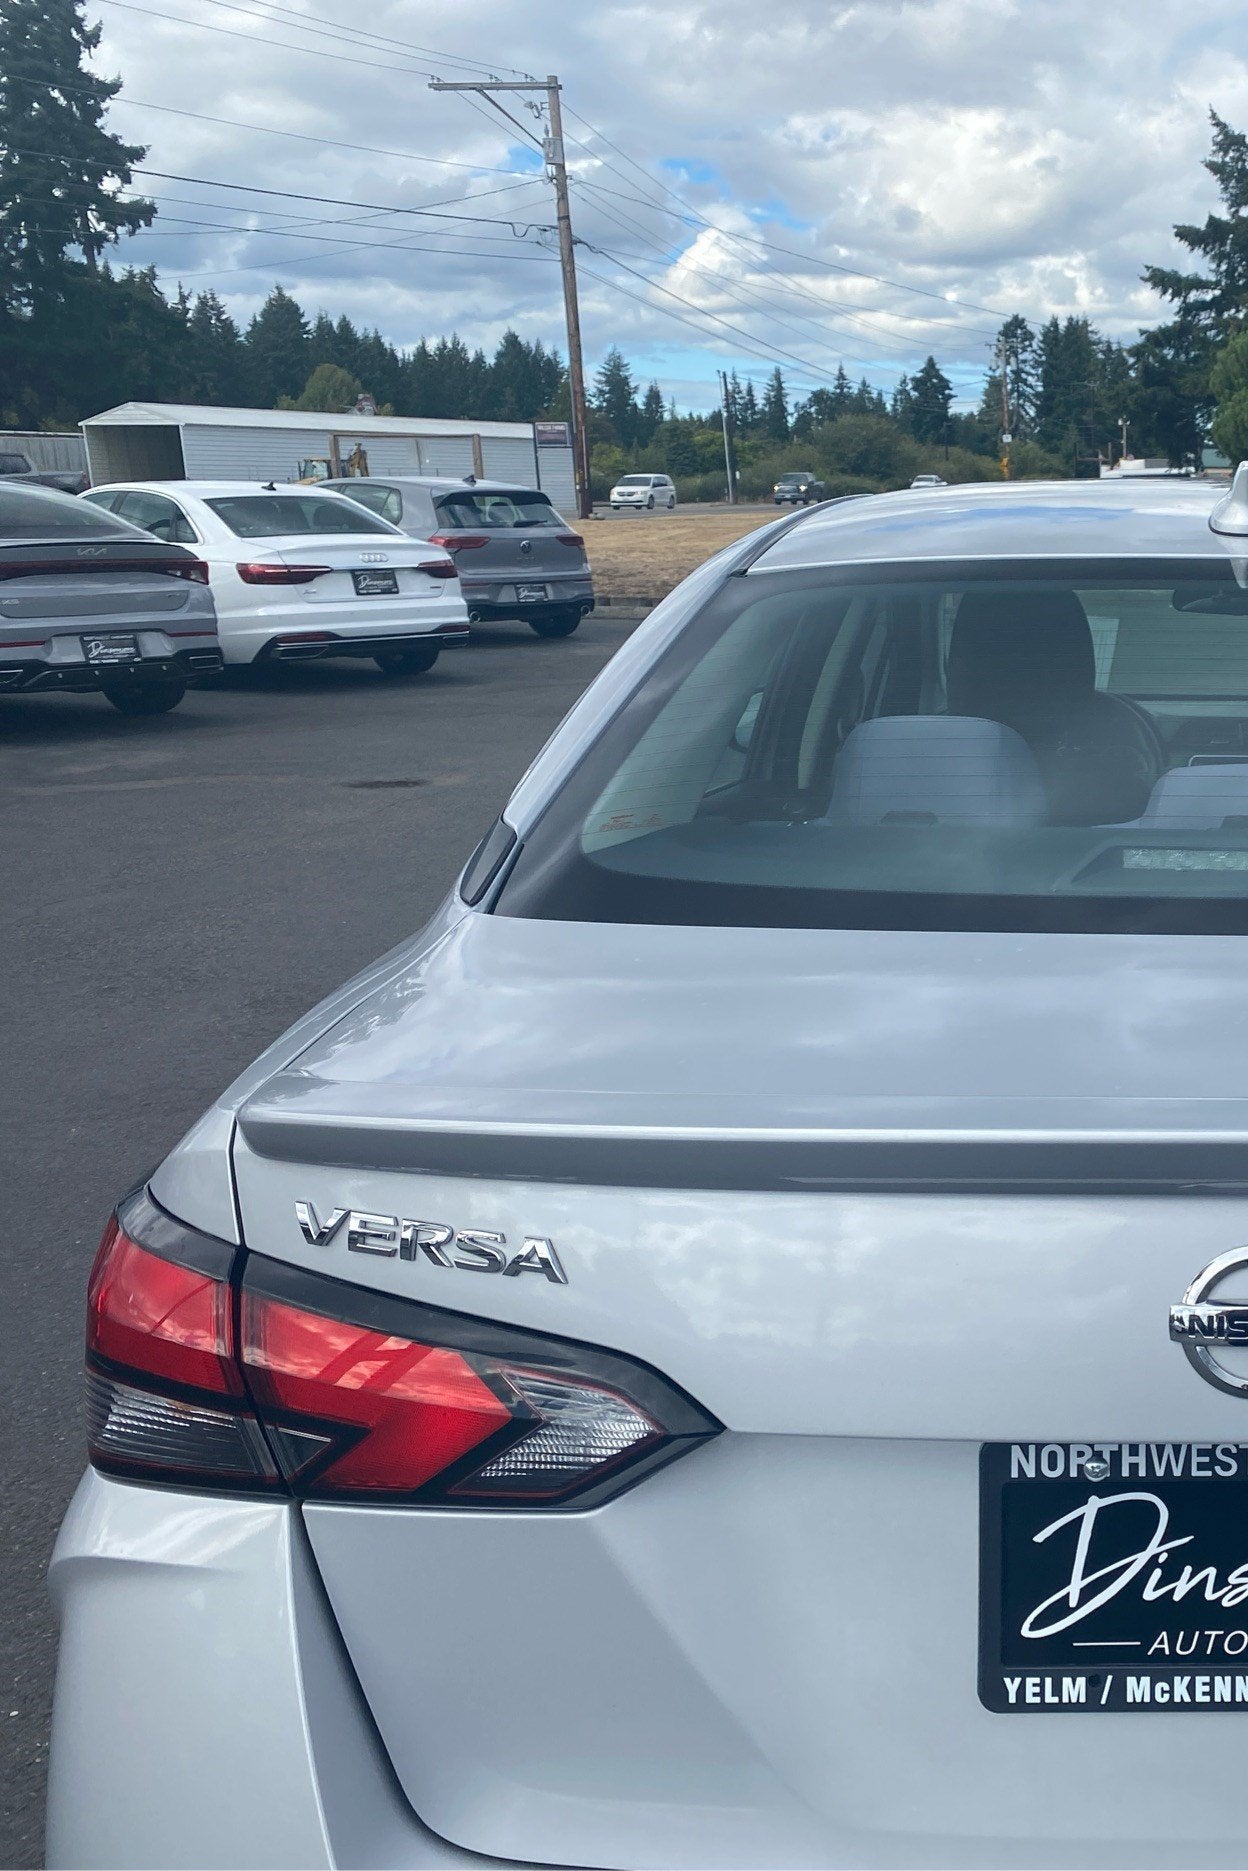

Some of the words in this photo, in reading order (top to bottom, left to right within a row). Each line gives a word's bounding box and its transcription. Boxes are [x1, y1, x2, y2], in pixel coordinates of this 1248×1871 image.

[295, 1200, 569, 1284] VERSA
[1147, 1630, 1248, 1656] AUTO
[1003, 1676, 1087, 1704] YELM
[1100, 1674, 1114, 1705] /
